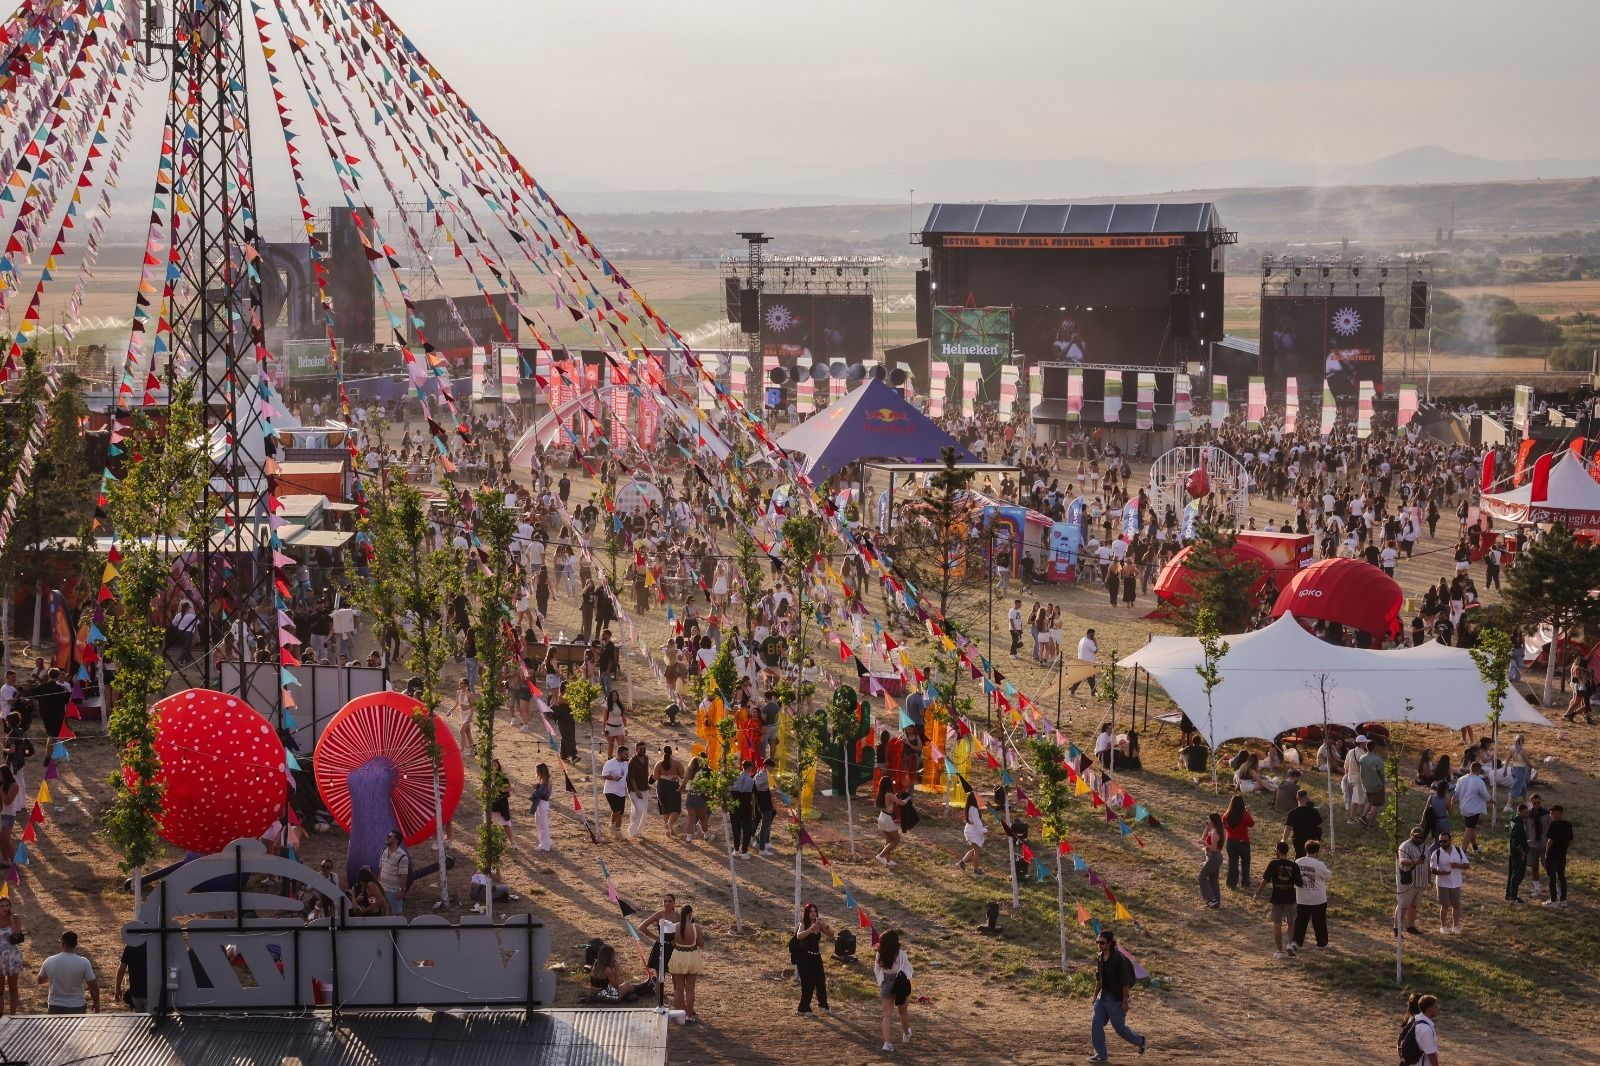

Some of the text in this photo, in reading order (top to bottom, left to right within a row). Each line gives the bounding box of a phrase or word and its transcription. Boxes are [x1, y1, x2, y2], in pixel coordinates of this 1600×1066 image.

[1145, 238, 1165, 246] HILL
[941, 343, 998, 355] Heineken
[297, 355, 326, 368] Heineken
[1553, 512, 1587, 526] Koegji
